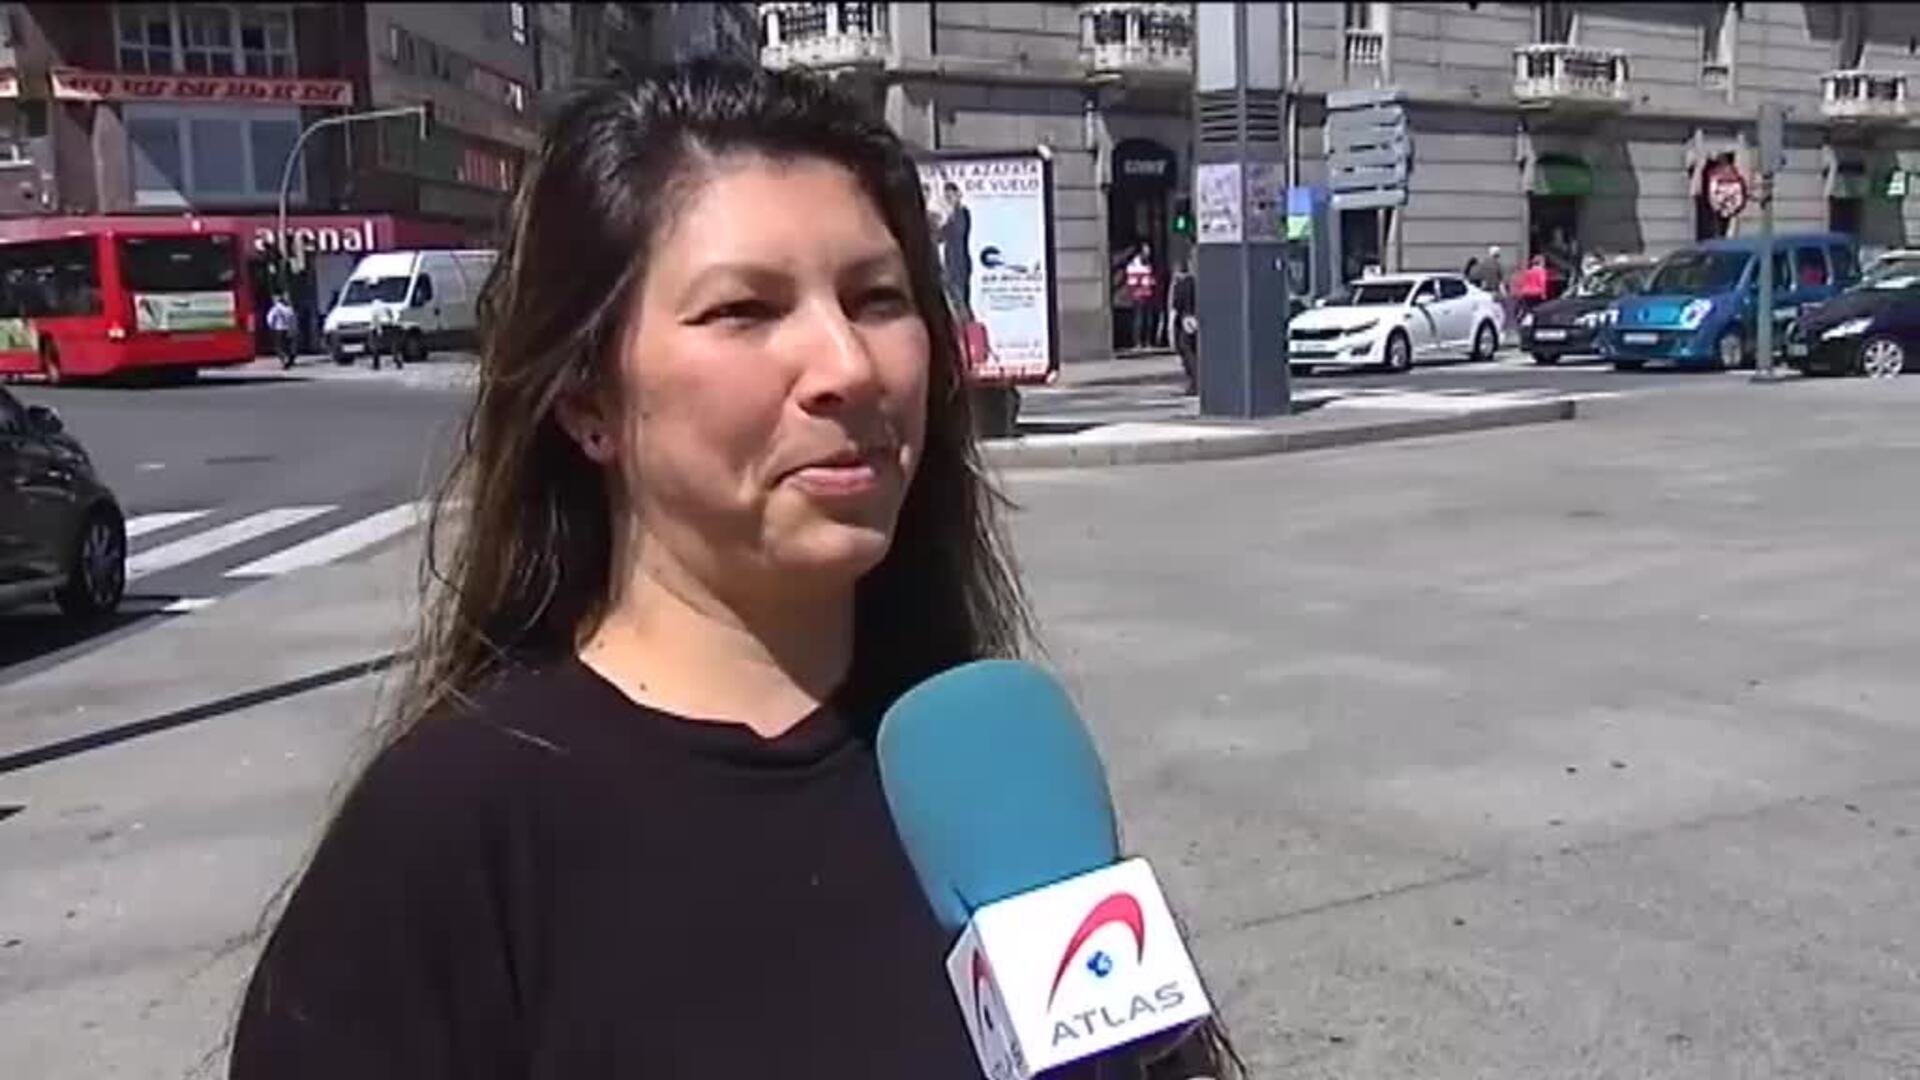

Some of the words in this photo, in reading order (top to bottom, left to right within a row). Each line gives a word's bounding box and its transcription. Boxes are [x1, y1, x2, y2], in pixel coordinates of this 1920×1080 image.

[972, 162, 1038, 177] AZAFATA
[964, 179, 985, 192] DE
[989, 178, 1040, 192] VUELO
[254, 219, 375, 251] arenal
[1051, 980, 1186, 1048] ATLAS
